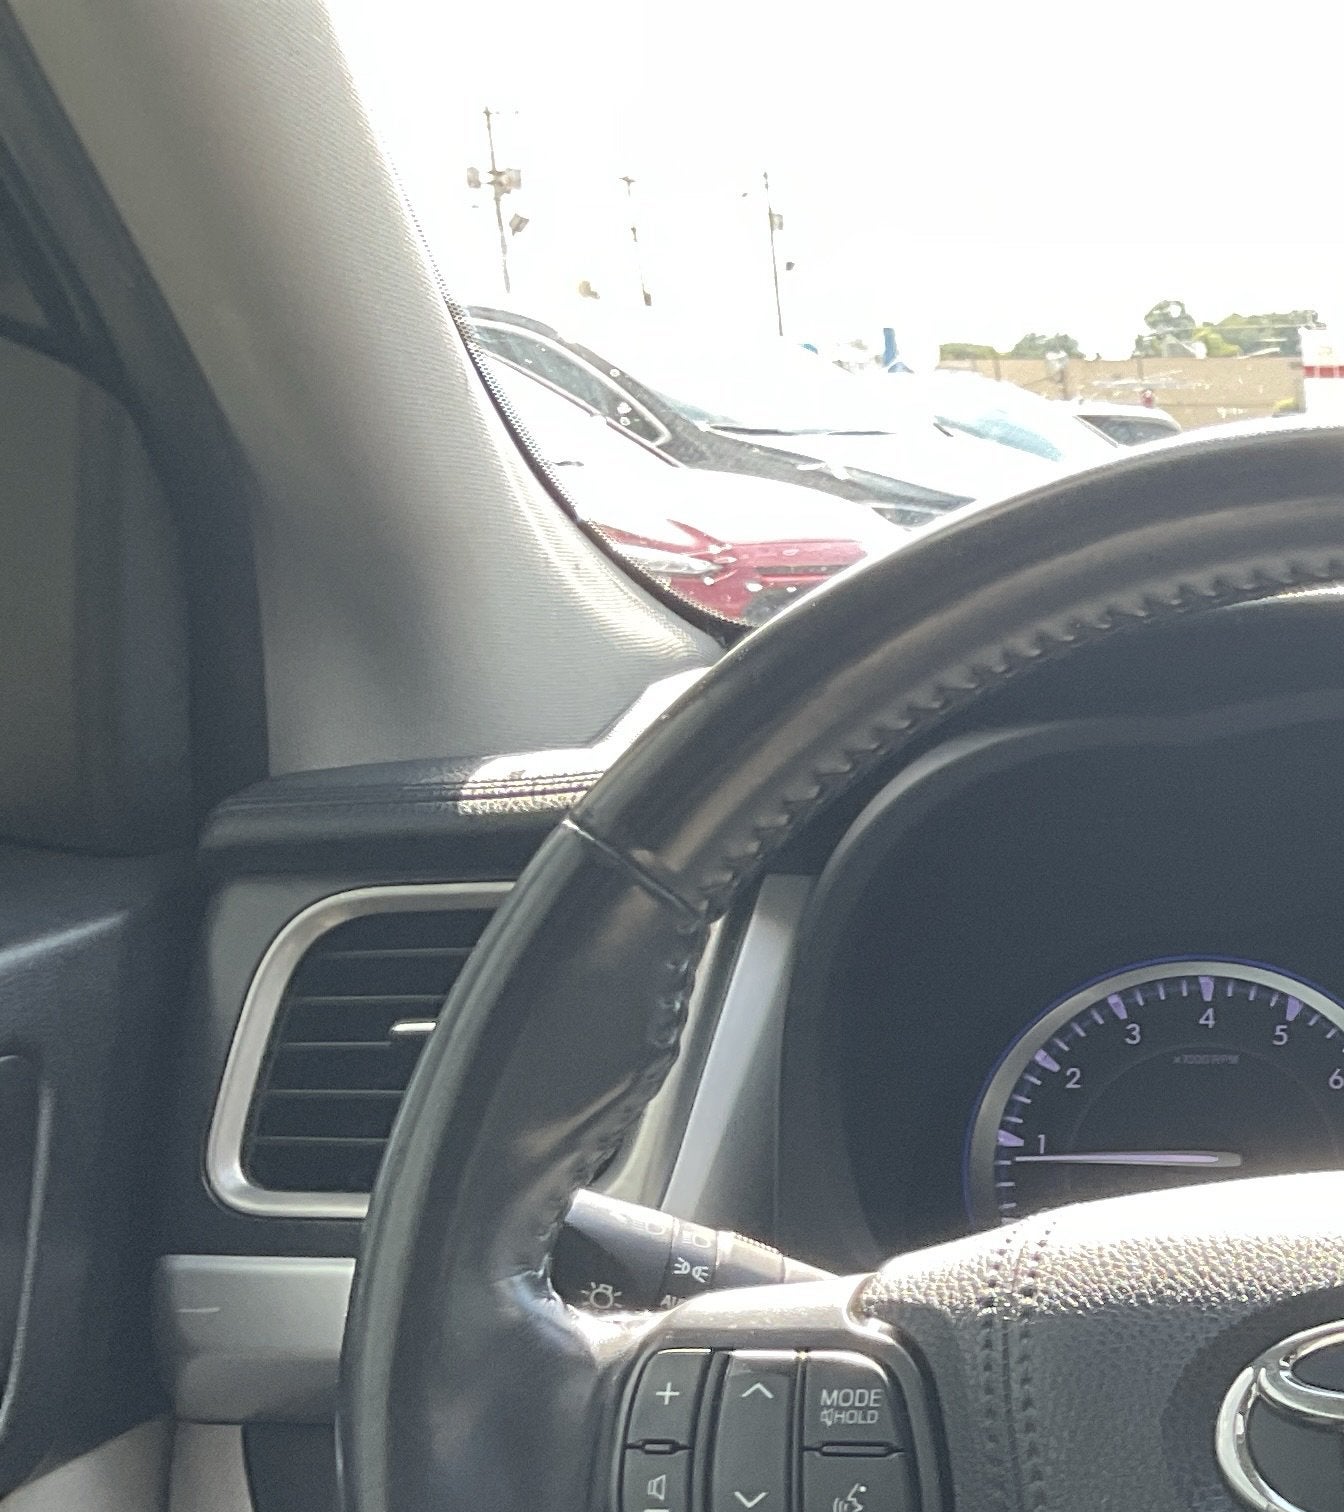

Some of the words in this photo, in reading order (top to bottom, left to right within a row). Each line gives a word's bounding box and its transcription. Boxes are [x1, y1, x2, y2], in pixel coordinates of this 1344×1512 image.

[1199, 1007, 1216, 1029] 4
[1125, 1023, 1142, 1045] 3
[1272, 1024, 1289, 1046] 5
[1065, 1067, 1082, 1090] 2
[1329, 1067, 1344, 1090] 6
[1037, 1134, 1047, 1154] 1
[820, 1388, 882, 1407] MODE
[833, 1408, 880, 1425] HOLD
